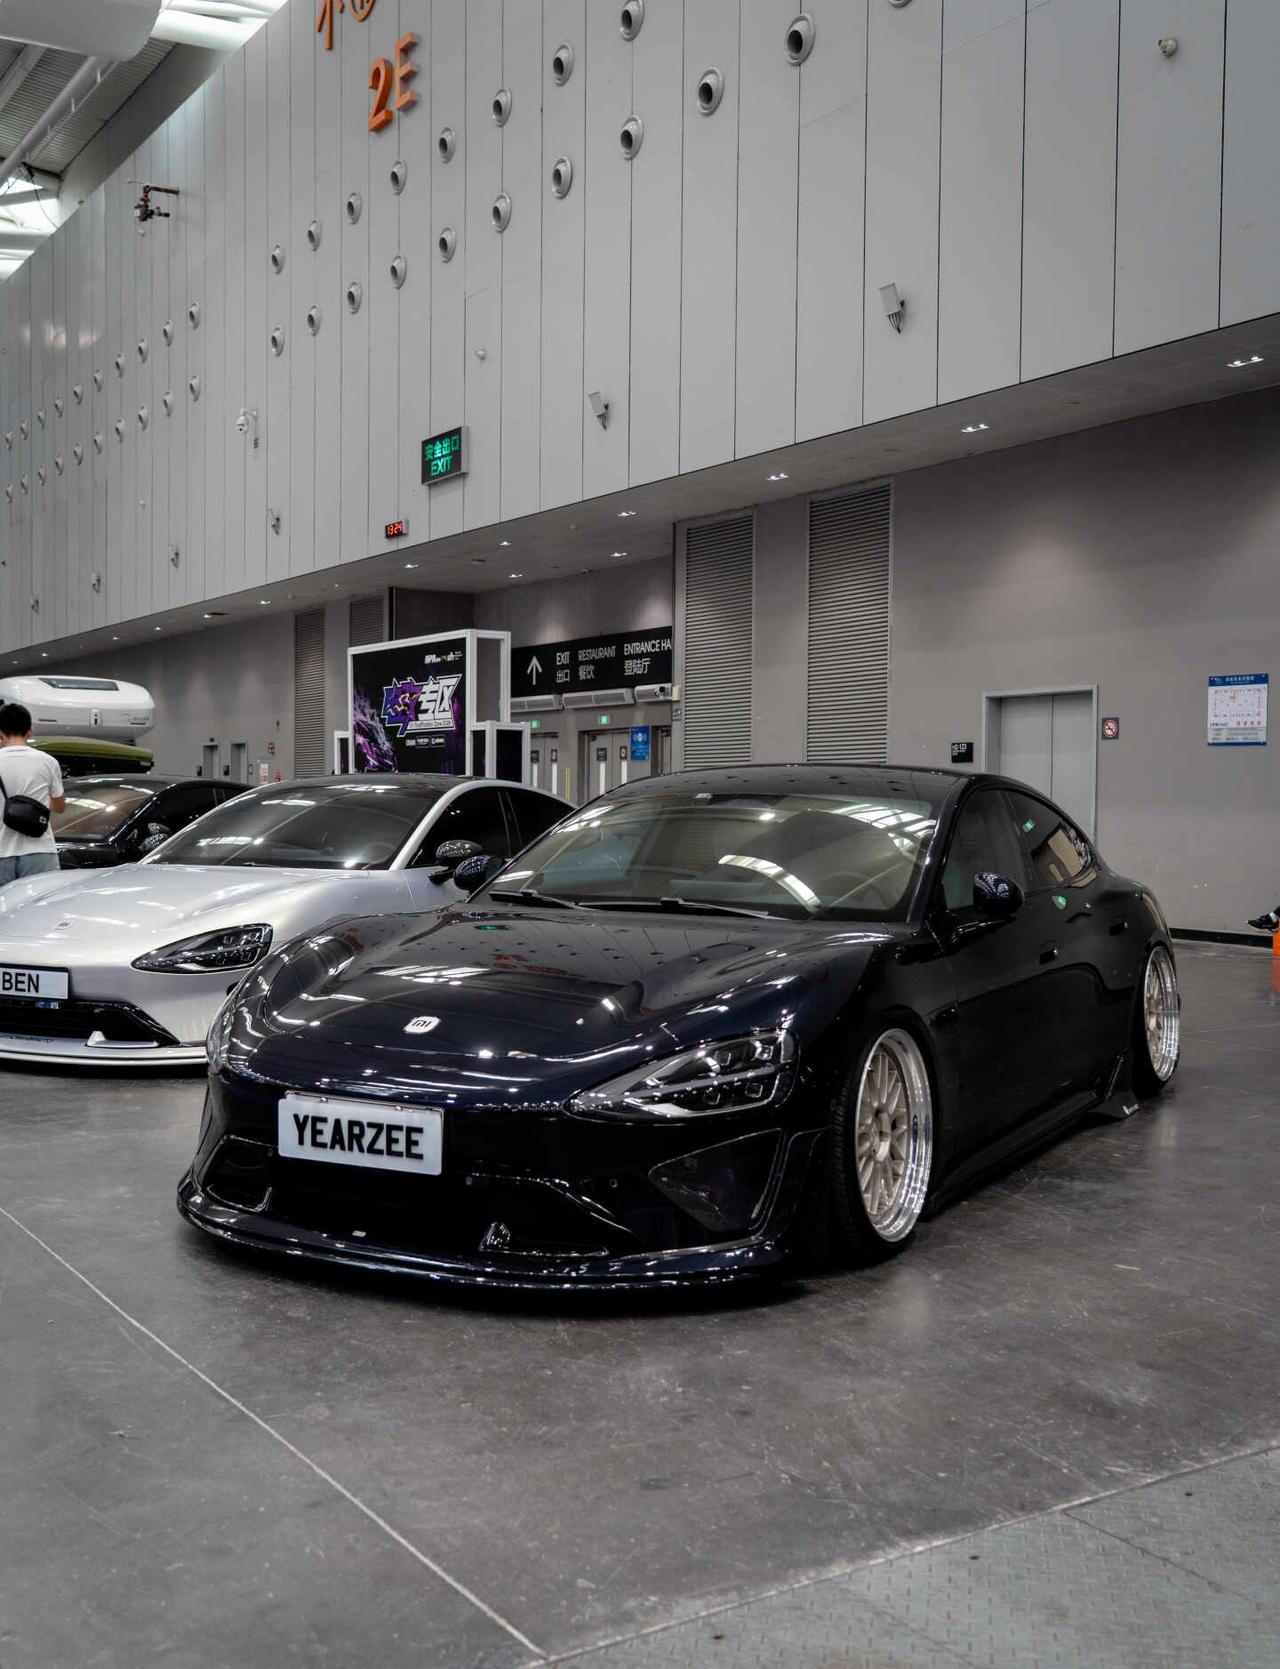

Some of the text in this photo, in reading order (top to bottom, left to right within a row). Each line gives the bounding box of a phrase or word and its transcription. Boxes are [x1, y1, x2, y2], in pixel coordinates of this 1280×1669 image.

[368, 32, 420, 132] 2E
[425, 435, 459, 460] 安全出口
[431, 455, 452, 476] EXIT
[556, 651, 570, 666] EXIT
[578, 645, 616, 661] RESTAURANT
[624, 640, 660, 655] ENTRANCE
[556, 669, 570, 683] 出口
[2, 971, 40, 993] BEN
[293, 1113, 424, 1160] YEARZEE
